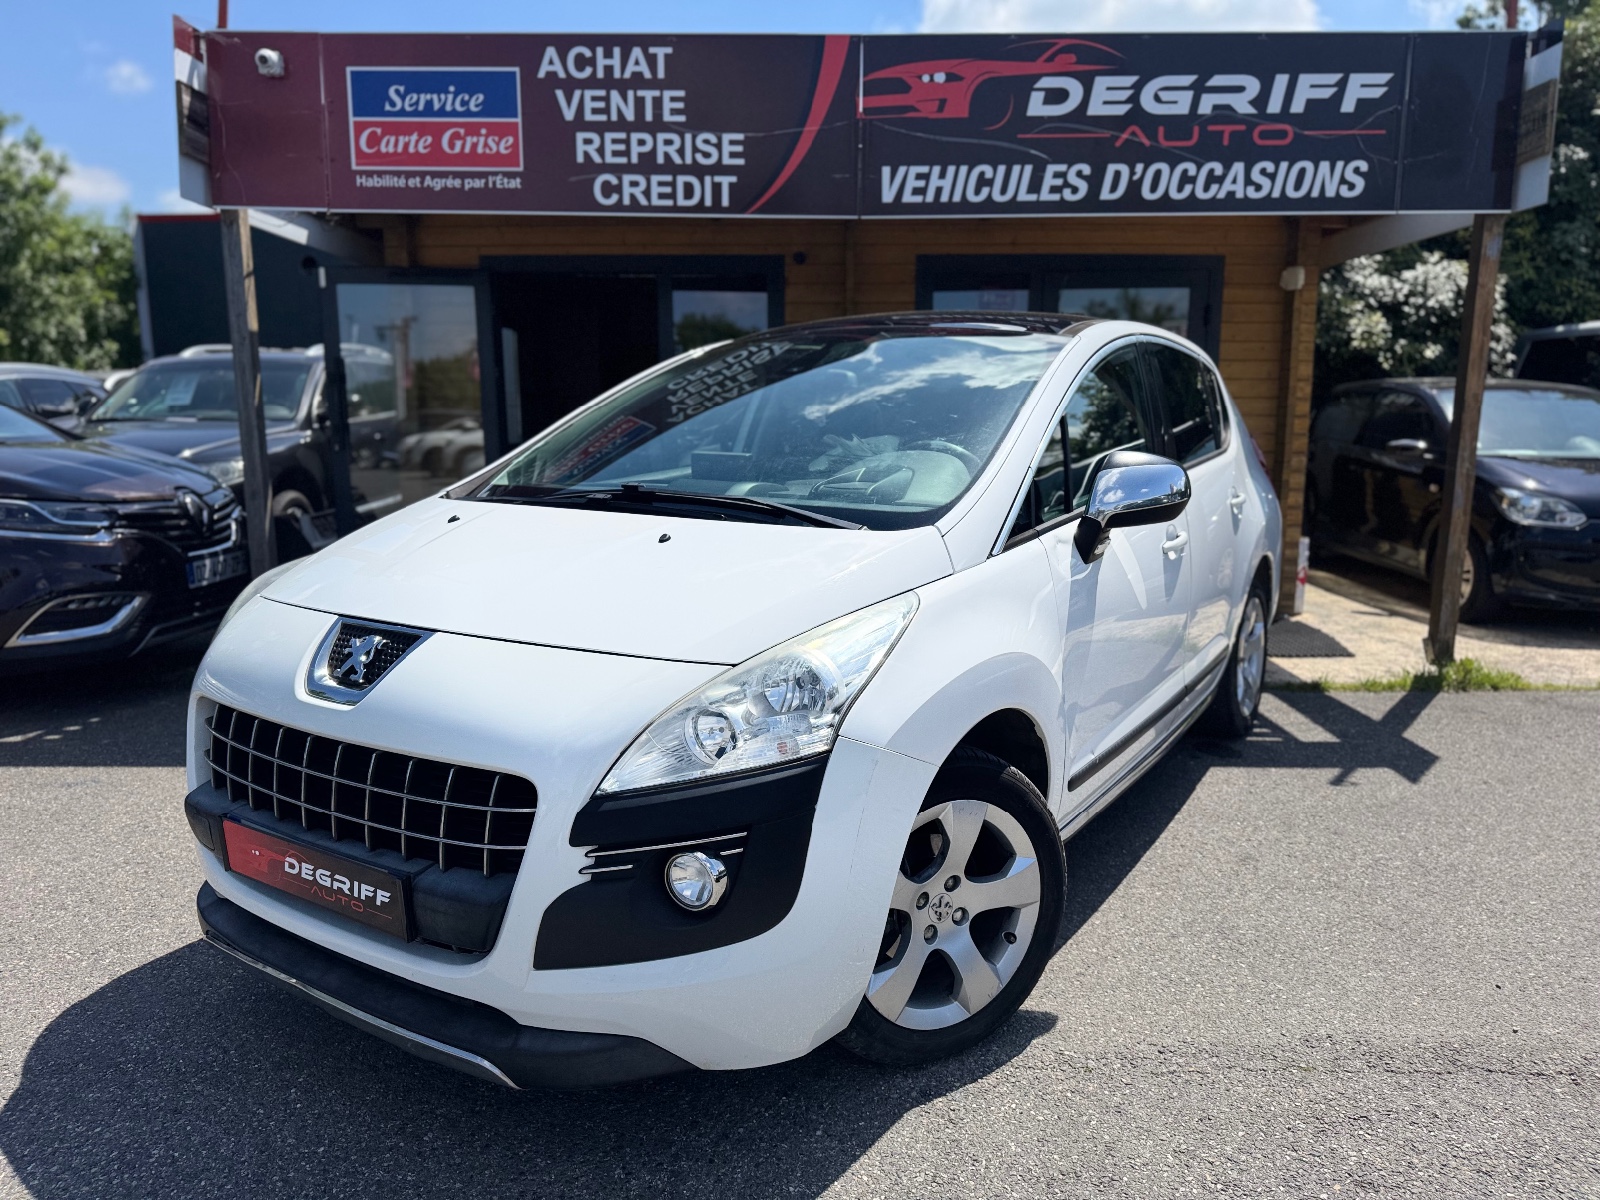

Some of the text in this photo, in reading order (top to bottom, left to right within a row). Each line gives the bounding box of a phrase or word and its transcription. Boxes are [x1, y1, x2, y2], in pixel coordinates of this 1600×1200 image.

[536, 45, 673, 79] ACHAT
[383, 84, 485, 112] Service
[554, 88, 687, 122] VENTE
[1025, 72, 1395, 117] DEGRIFF
[358, 126, 514, 155] Carte Grise
[574, 131, 746, 166] REPRISE
[1113, 124, 1294, 147] AUTO
[355, 174, 406, 188] Habilité
[407, 176, 421, 188] et
[423, 175, 462, 191] Agrée
[464, 176, 486, 191] par
[592, 173, 738, 208] CREDIT
[880, 160, 1369, 204] VEHICULES D'OCCASIONS
[284, 856, 391, 906] DEGRIFF
[310, 885, 364, 912] AUTO
